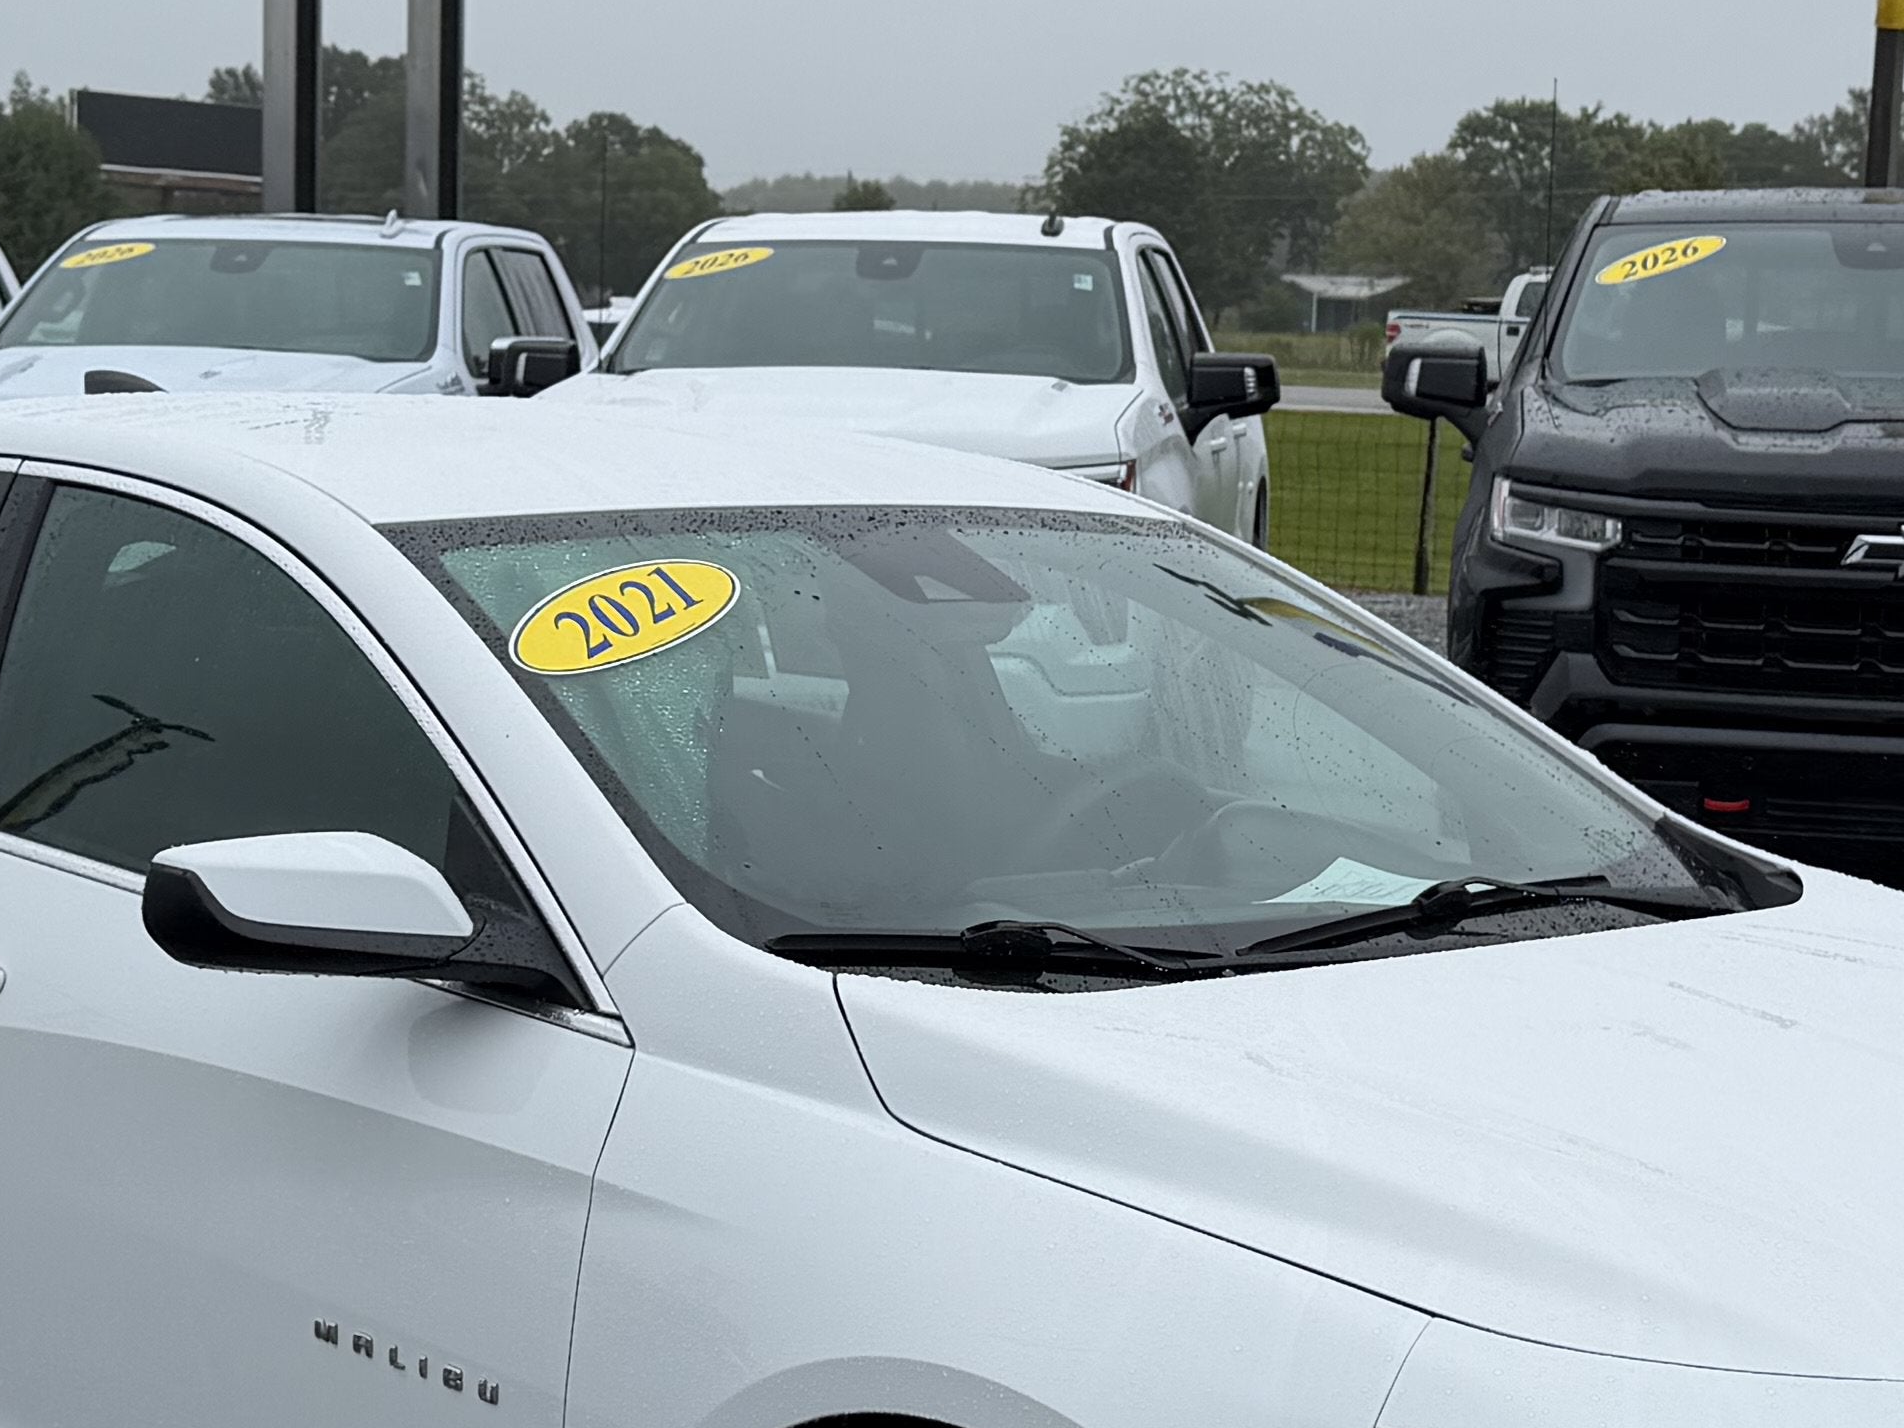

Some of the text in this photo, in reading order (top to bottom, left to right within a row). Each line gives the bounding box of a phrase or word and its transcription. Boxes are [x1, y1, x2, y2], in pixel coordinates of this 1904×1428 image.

[683, 252, 749, 275] 2026
[1620, 241, 1700, 280] 2026
[553, 567, 704, 659] 2021
[313, 1317, 500, 1406] MALIBU
